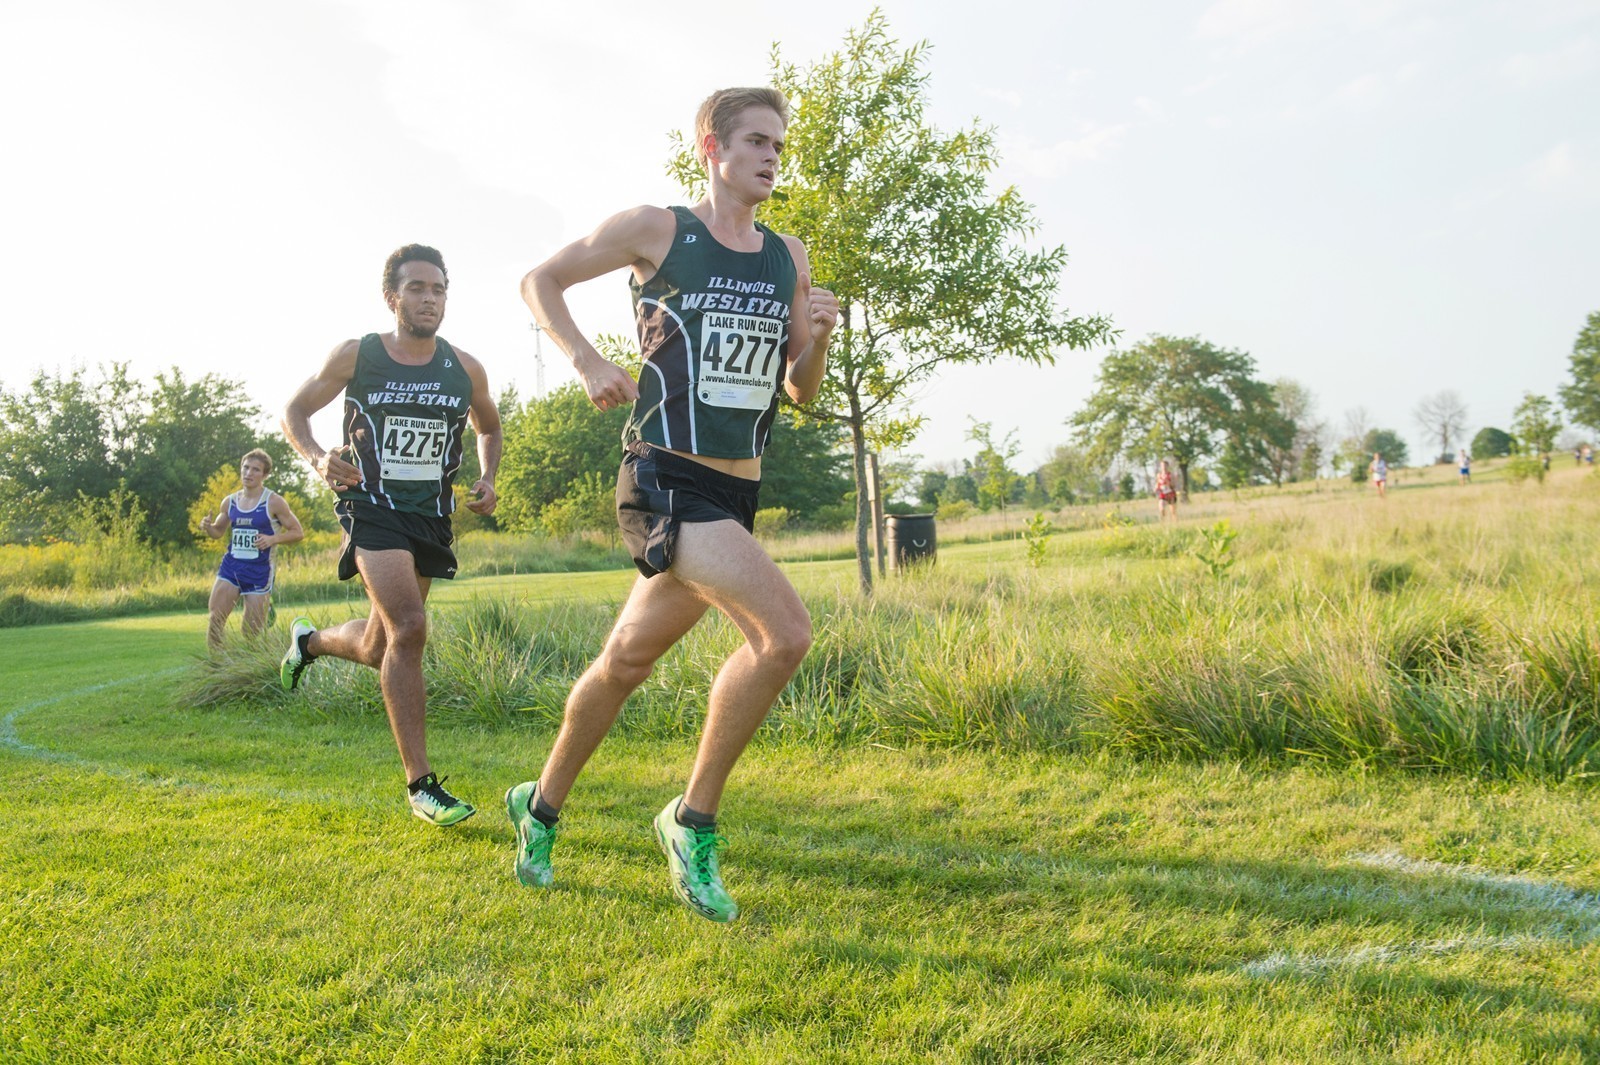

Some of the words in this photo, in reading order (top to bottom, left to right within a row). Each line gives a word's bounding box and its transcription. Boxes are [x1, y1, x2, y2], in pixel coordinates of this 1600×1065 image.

[707, 276, 776, 295] ILLINOIS
[709, 315, 735, 330] LAKE
[737, 318, 756, 332] RUN
[758, 320, 779, 334] CLUB
[702, 331, 779, 377] 4277
[385, 381, 441, 392] ILLINOIS
[705, 374, 772, 389] www.lakerunclub.org
[367, 392, 461, 408] WESLEYAN
[389, 418, 409, 428] LAKE
[410, 420, 426, 429] RUN
[428, 421, 444, 430] CLUB
[384, 428, 447, 458] 4275
[386, 458, 439, 466] www.lakerunclub.org
